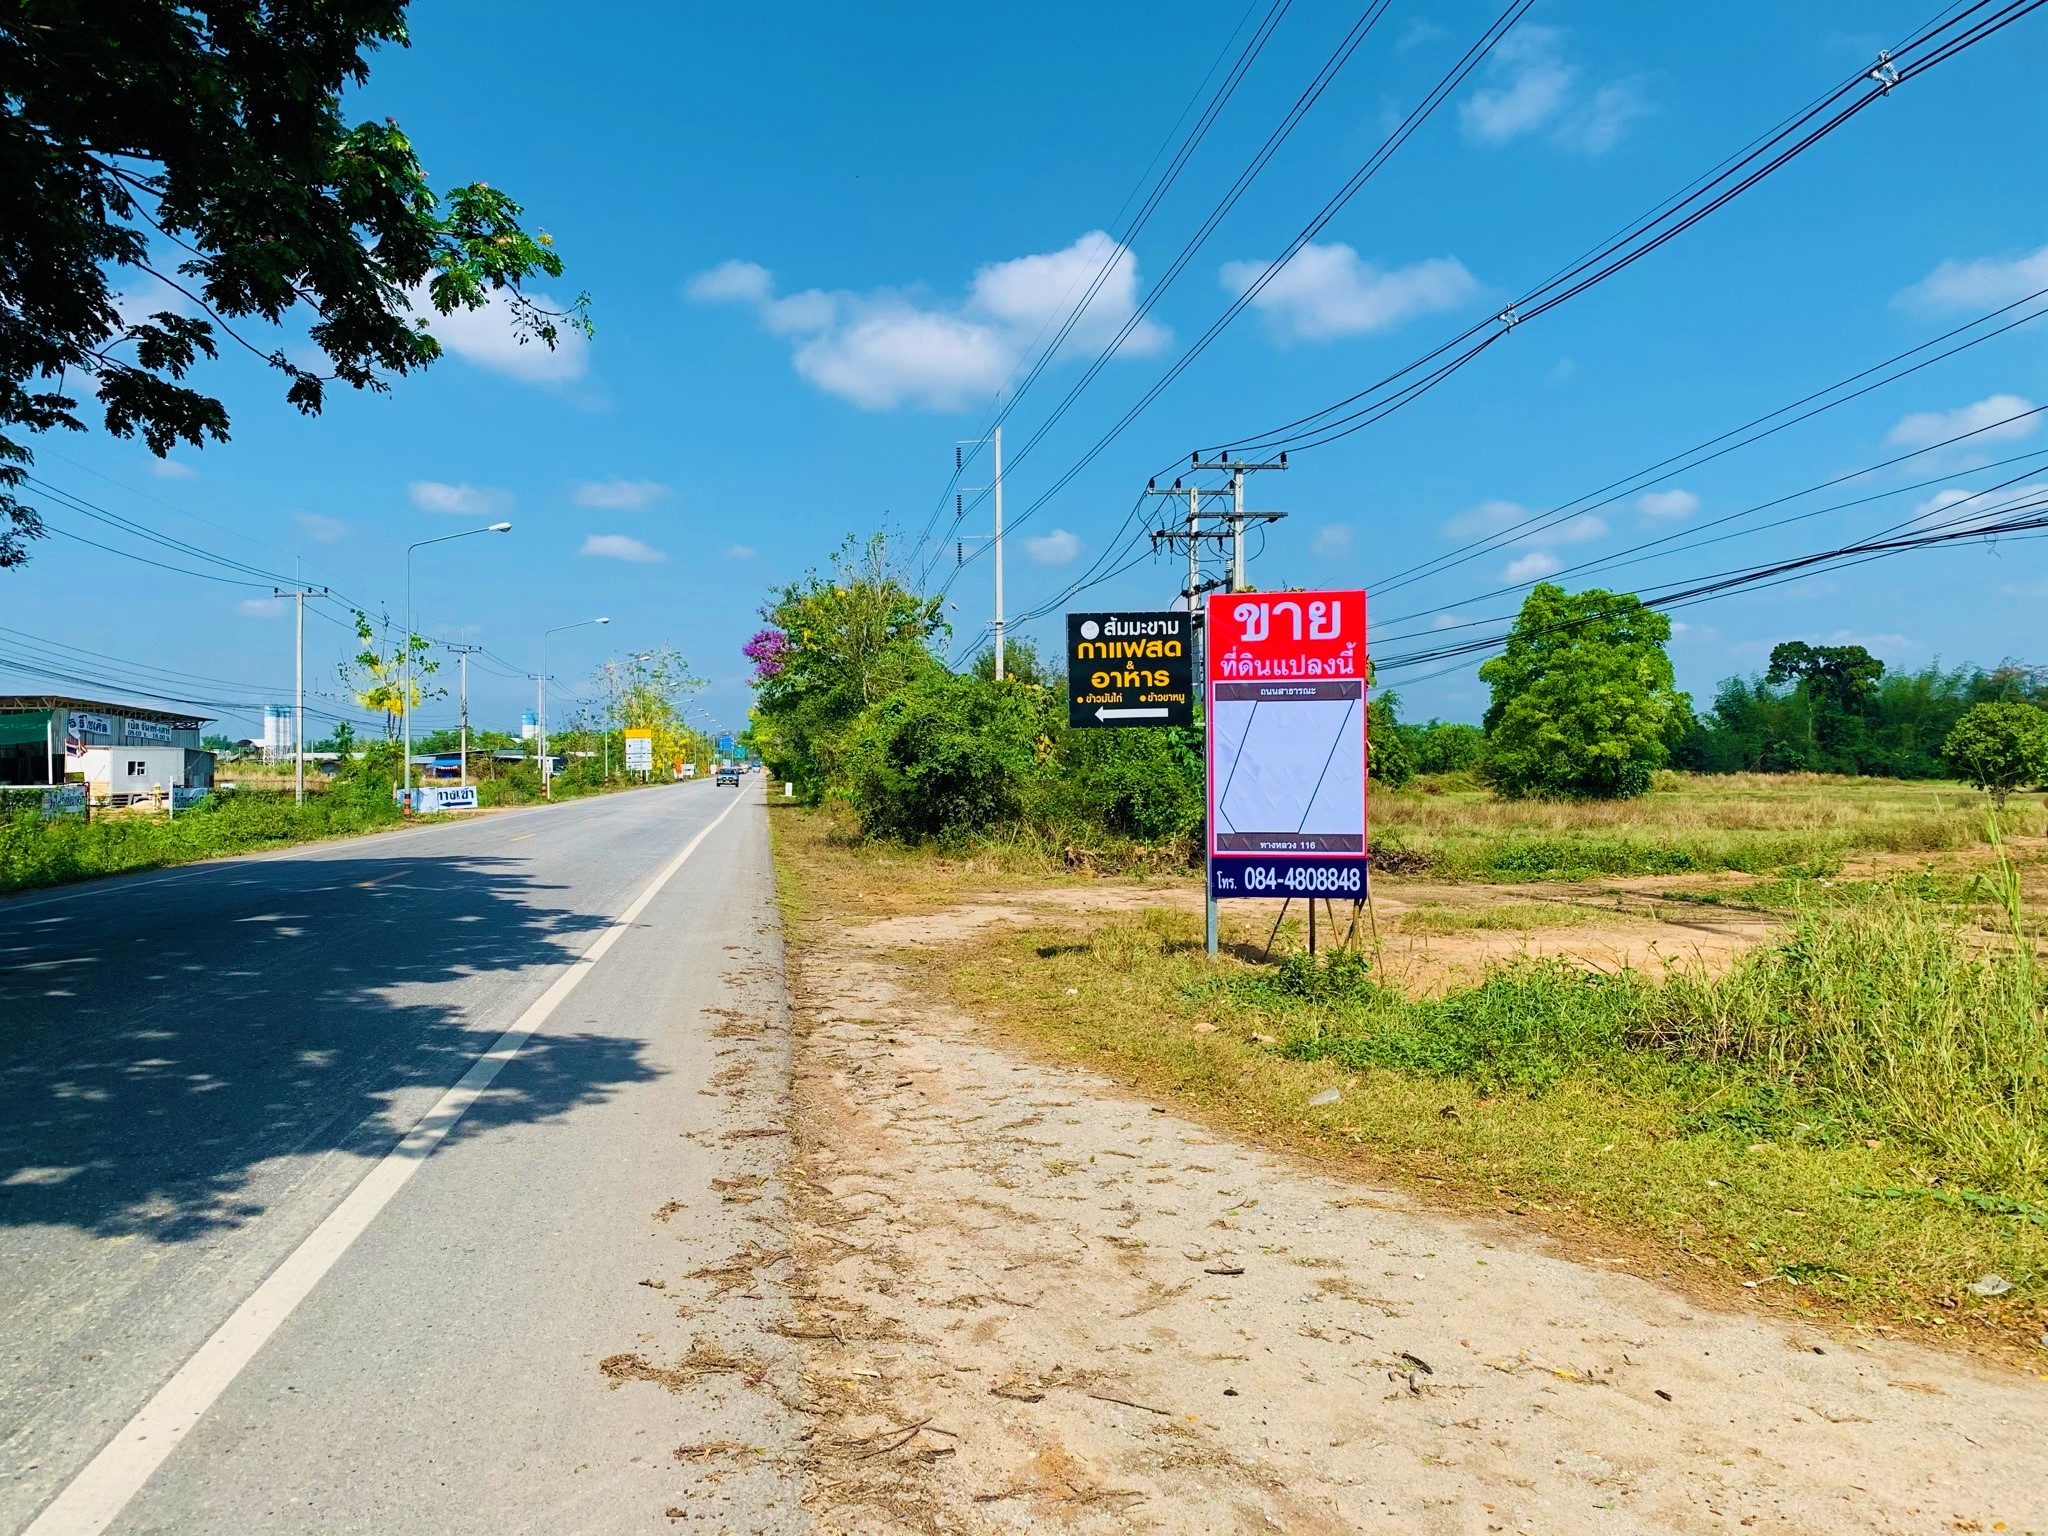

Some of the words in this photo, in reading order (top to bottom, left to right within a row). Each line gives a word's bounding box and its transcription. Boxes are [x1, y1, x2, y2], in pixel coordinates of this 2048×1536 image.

[1104, 616, 1179, 636] ส้มมะขาม
[1233, 600, 1342, 642] ขาย
[1078, 638, 1182, 659] กาแฟสด
[1126, 660, 1135, 670] &
[1220, 642, 1357, 677] ที่ดินแปลงนี้
[1091, 669, 1170, 688] อาหาร
[1085, 692, 1123, 704] ข้าวมันไก่
[1147, 692, 1185, 704] ข้าวขาหมู
[1260, 686, 1317, 696] ถนนสาธารณะ
[1259, 841, 1297, 850] ทางหลวง
[1300, 841, 1316, 849] 116
[1216, 870, 1237, 890] โทร.
[1244, 866, 1361, 891] 084-4808848
